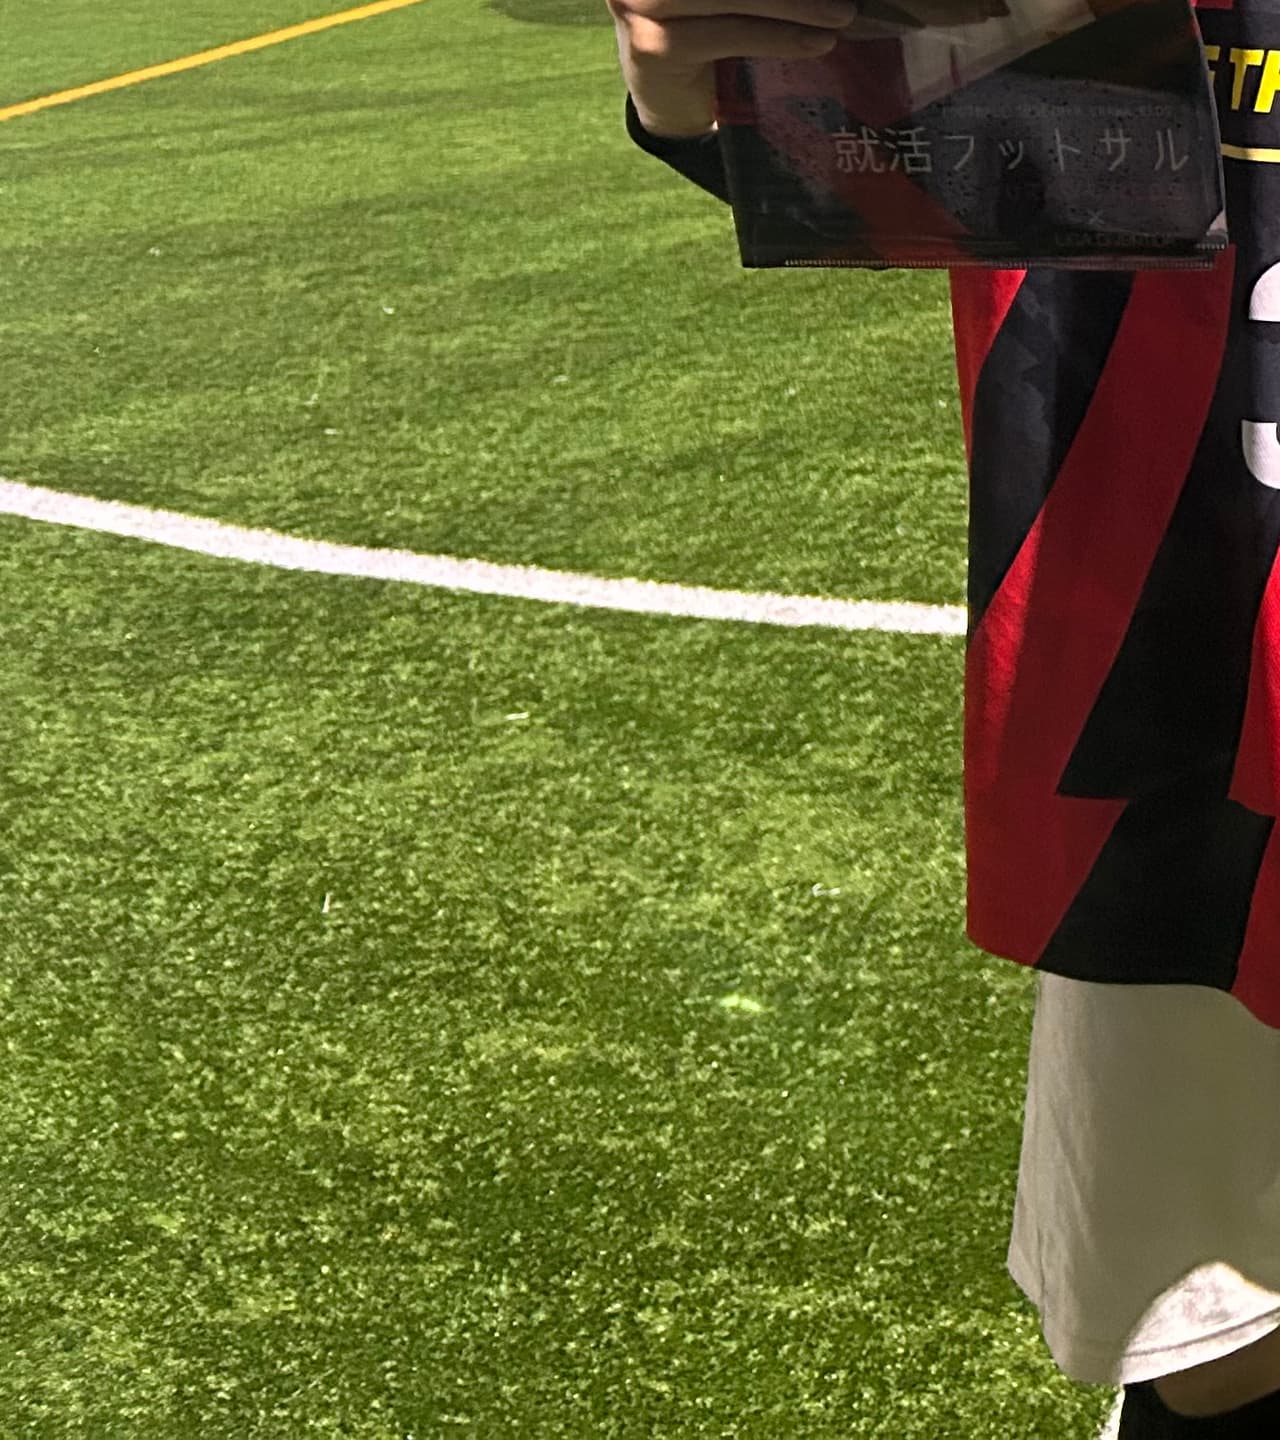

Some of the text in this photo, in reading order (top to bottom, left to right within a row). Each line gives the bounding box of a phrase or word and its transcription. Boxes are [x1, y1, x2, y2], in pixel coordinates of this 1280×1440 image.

[831, 124, 1190, 174] 就活フットサル
